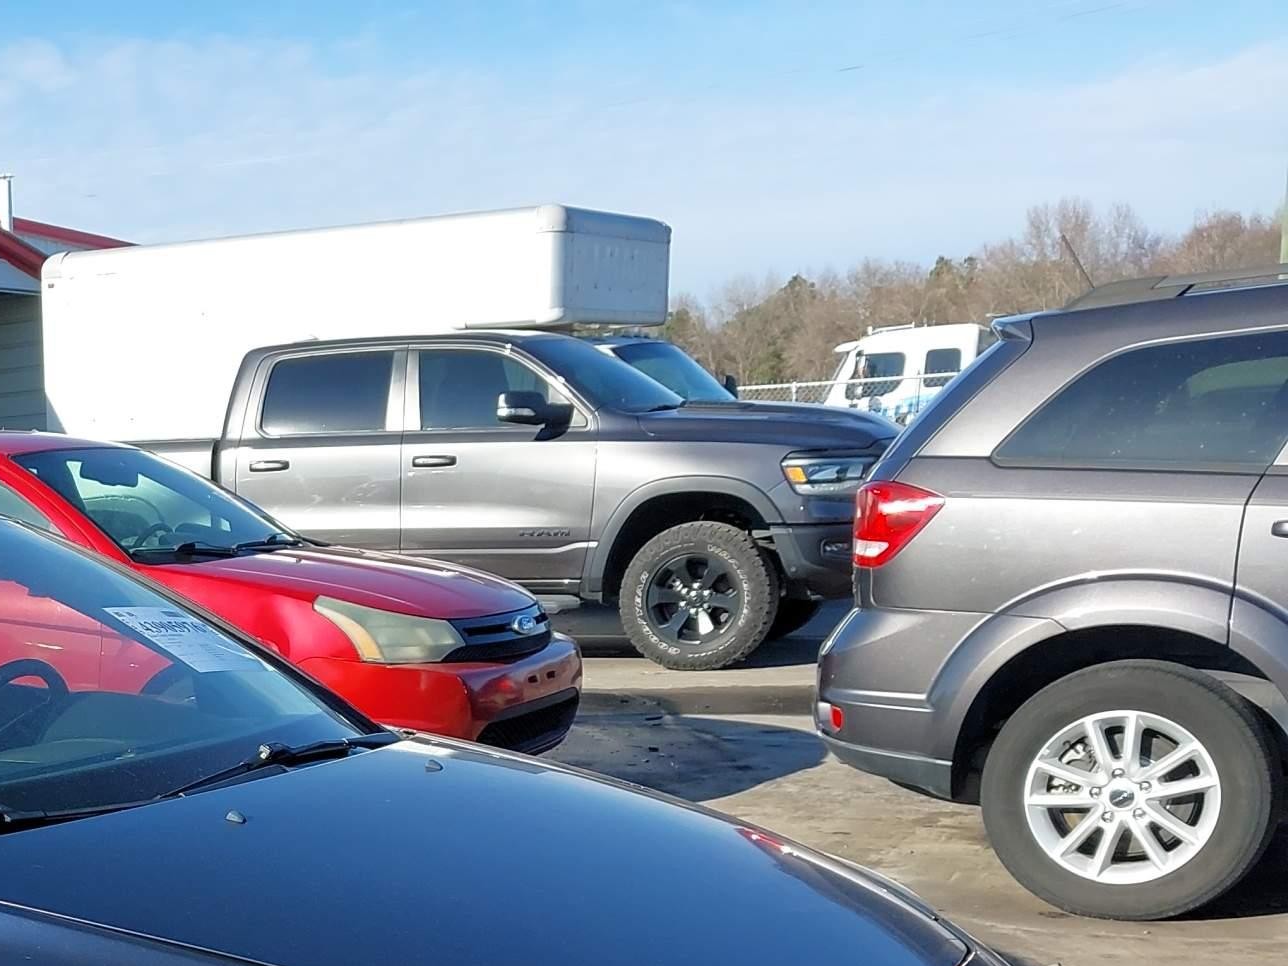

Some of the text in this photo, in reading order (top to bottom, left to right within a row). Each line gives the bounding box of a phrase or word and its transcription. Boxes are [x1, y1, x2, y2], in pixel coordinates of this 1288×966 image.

[519, 527, 570, 537] RAM
[634, 570, 680, 655] GOODYEAR
[137, 620, 207, 634] 43905976
